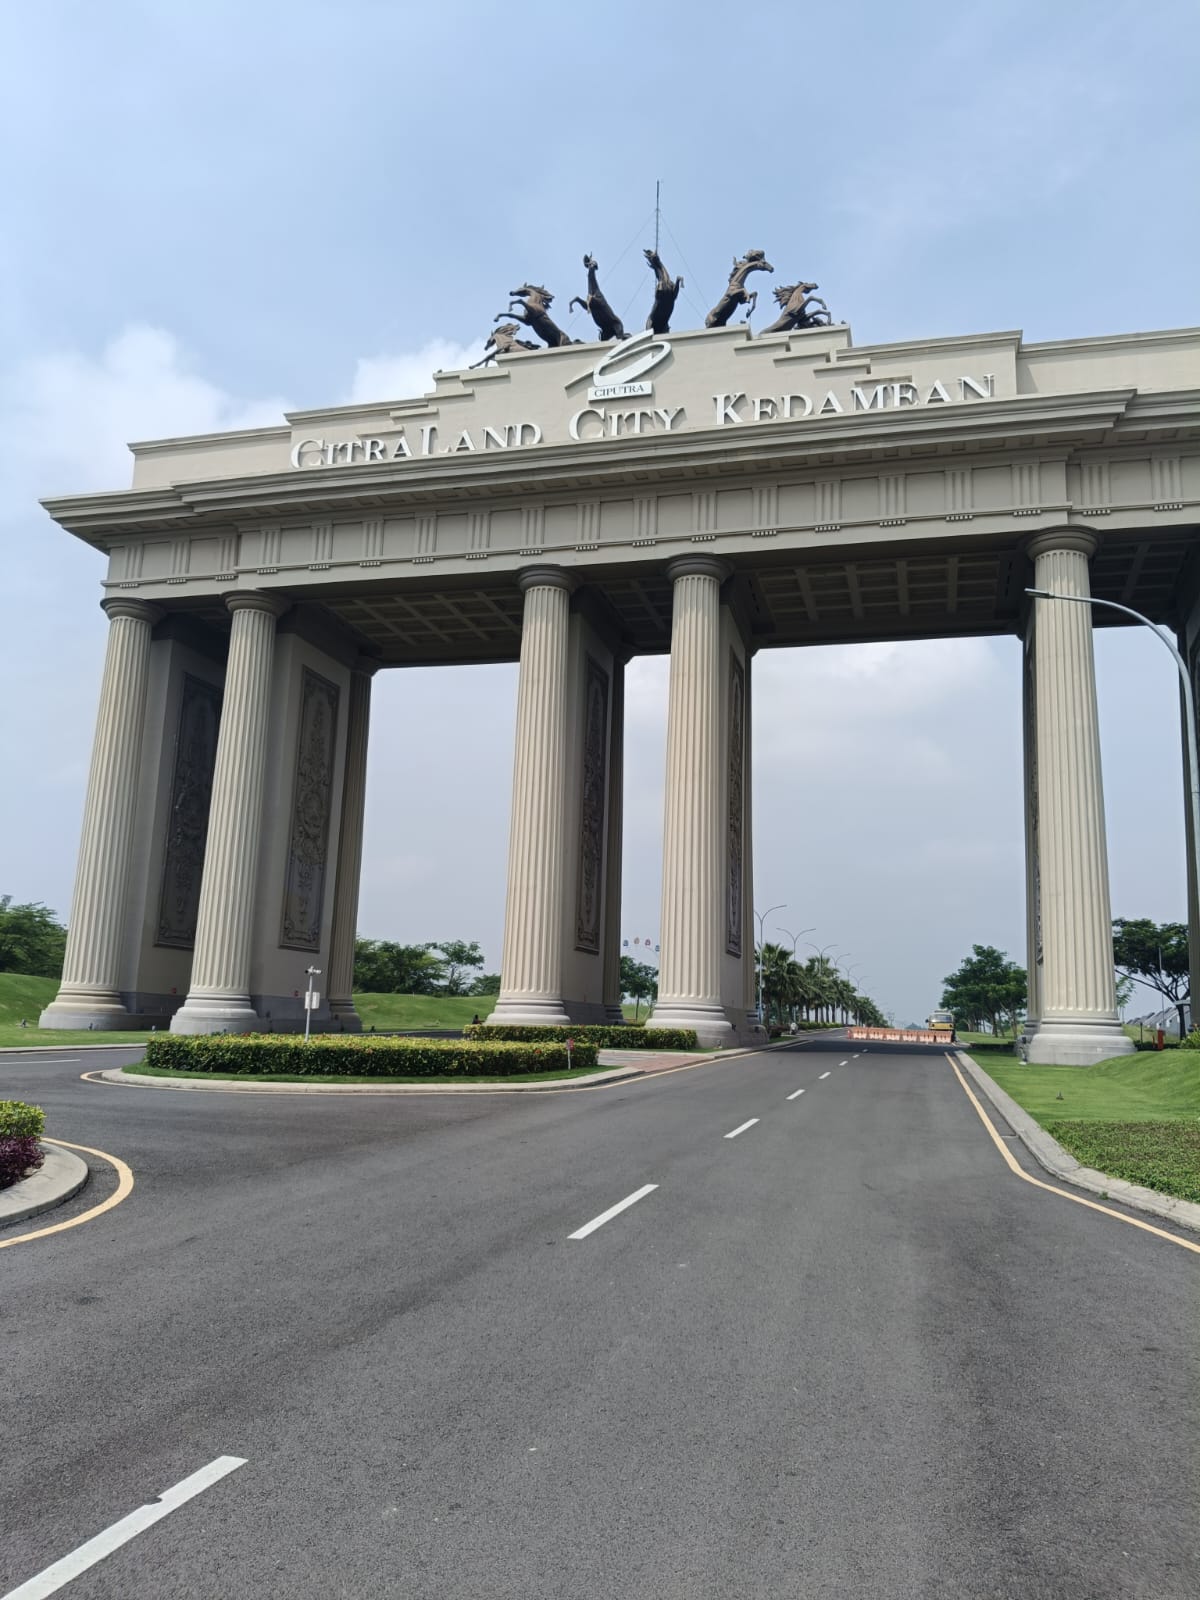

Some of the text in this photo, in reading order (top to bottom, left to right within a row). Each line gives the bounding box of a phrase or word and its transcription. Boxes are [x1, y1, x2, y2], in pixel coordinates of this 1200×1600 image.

[569, 407, 685, 441] CITY
[712, 373, 995, 425] KEDAMEAN
[594, 384, 644, 397] CIPUTRA
